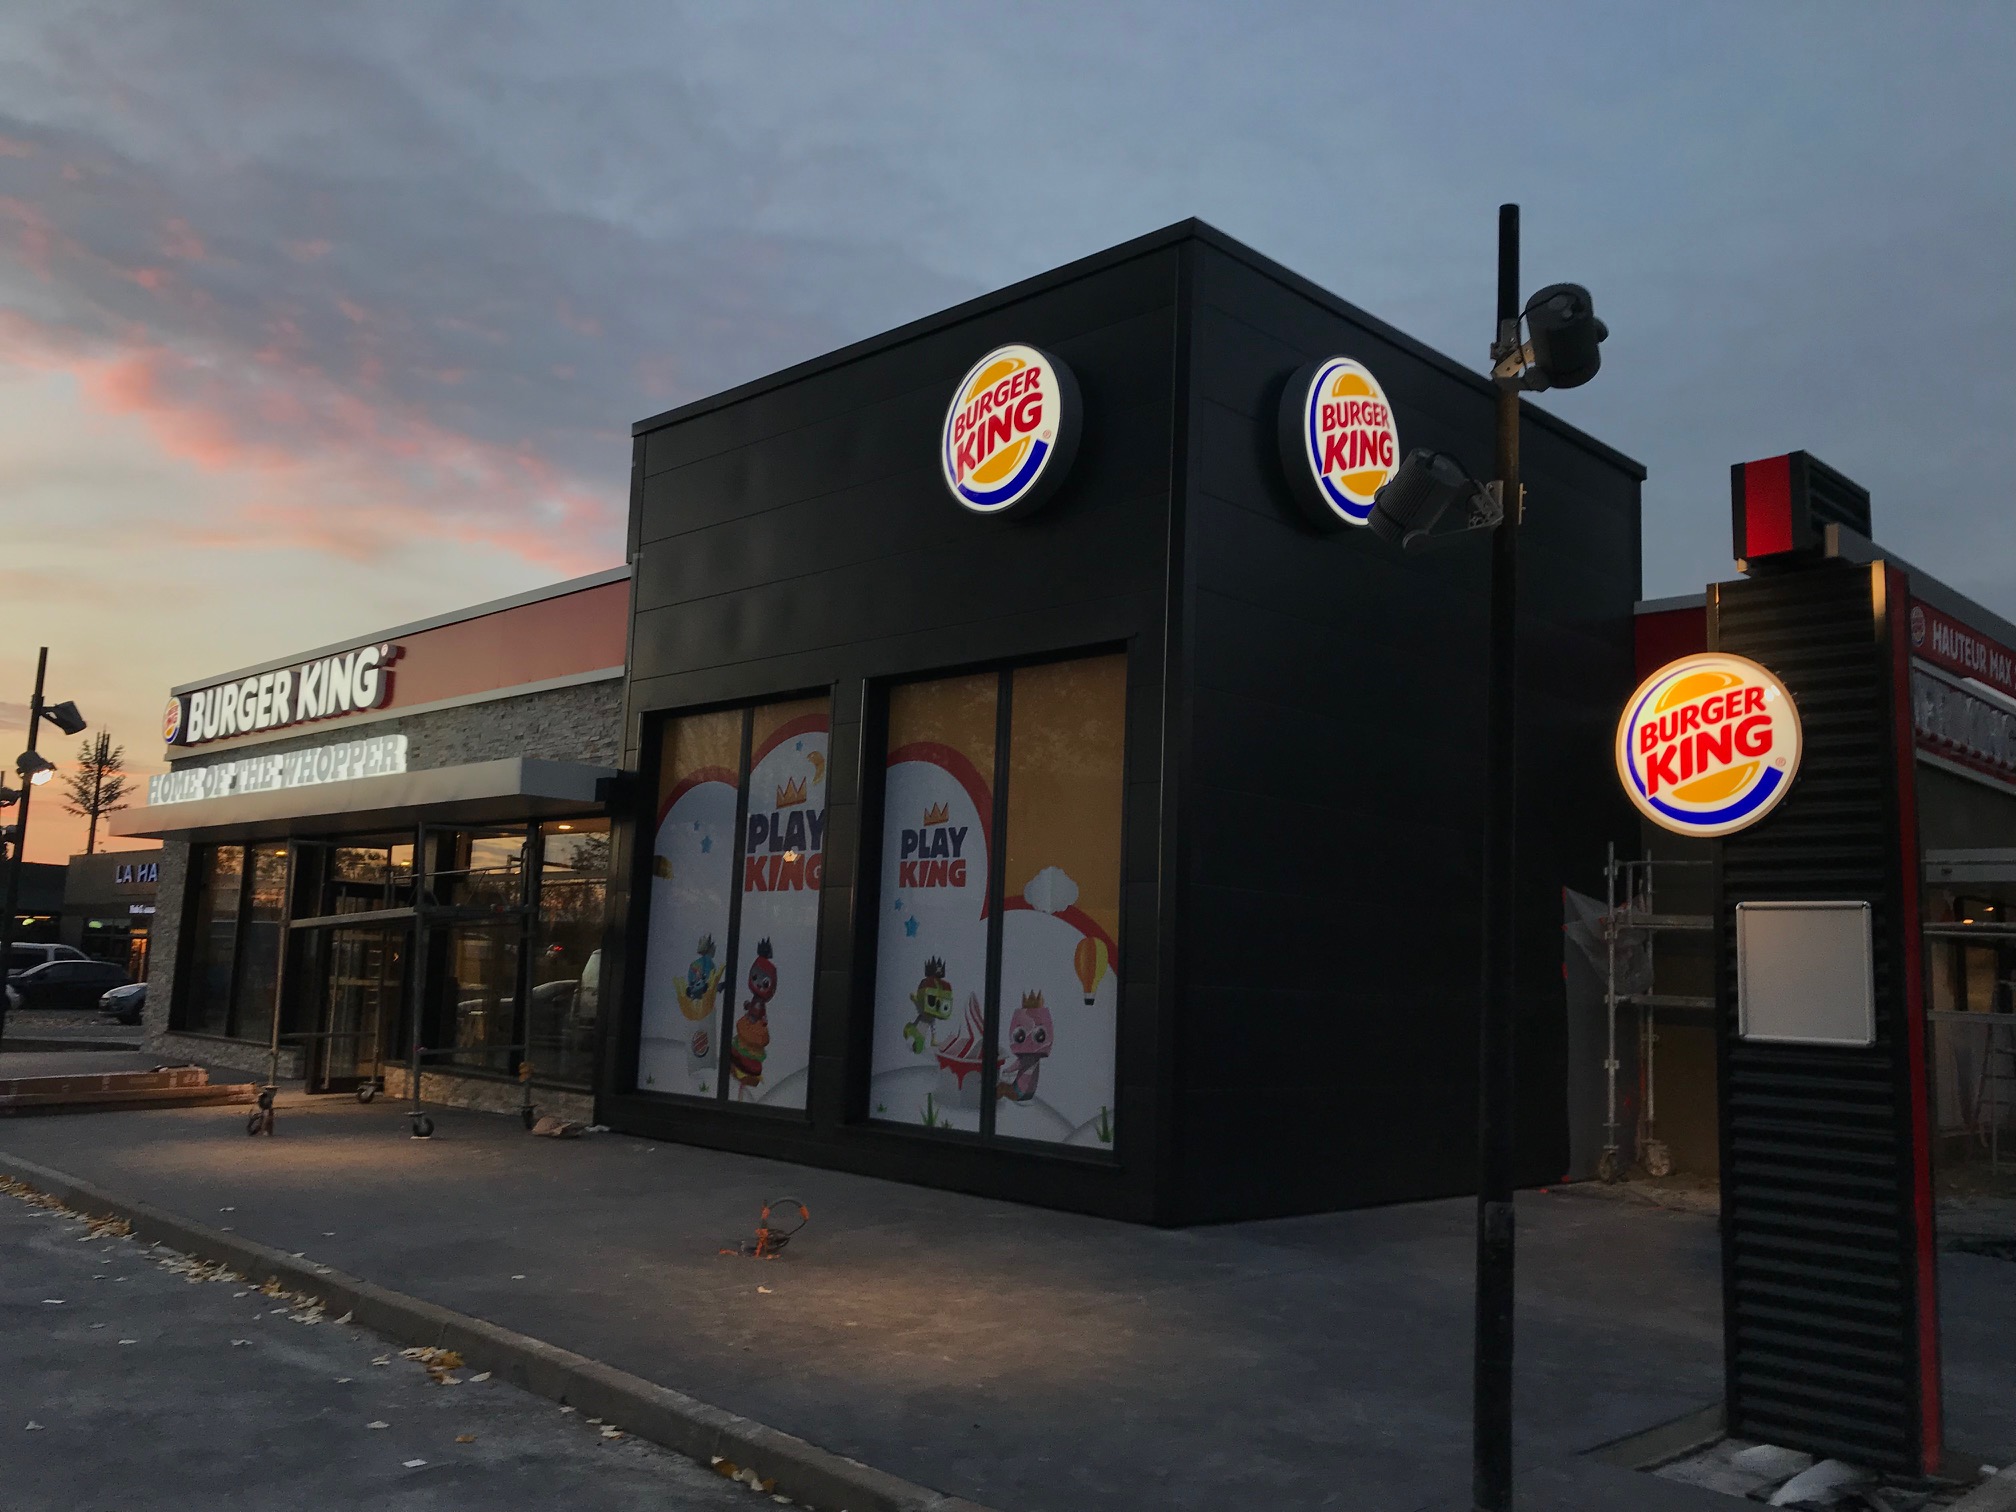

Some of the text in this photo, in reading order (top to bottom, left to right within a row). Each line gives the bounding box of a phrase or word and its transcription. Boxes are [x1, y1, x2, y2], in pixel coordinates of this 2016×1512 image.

[954, 366, 1041, 445] BURGER
[1322, 401, 1390, 433] BURGER
[956, 392, 1043, 486] KING
[1323, 429, 1393, 475] KING
[1932, 619, 1987, 674] HAUTEUR
[1989, 649, 2012, 687] MAX
[186, 645, 380, 743] BURGER KING
[1640, 686, 1767, 755] BURGER
[148, 734, 399, 804] HOME OF THE WHOPPER
[1646, 715, 1773, 797] KING
[747, 809, 825, 853] PLAY
[901, 826, 968, 859] PLAY
[115, 864, 133, 883] LA
[744, 853, 822, 892] KING
[899, 859, 966, 888] KING
